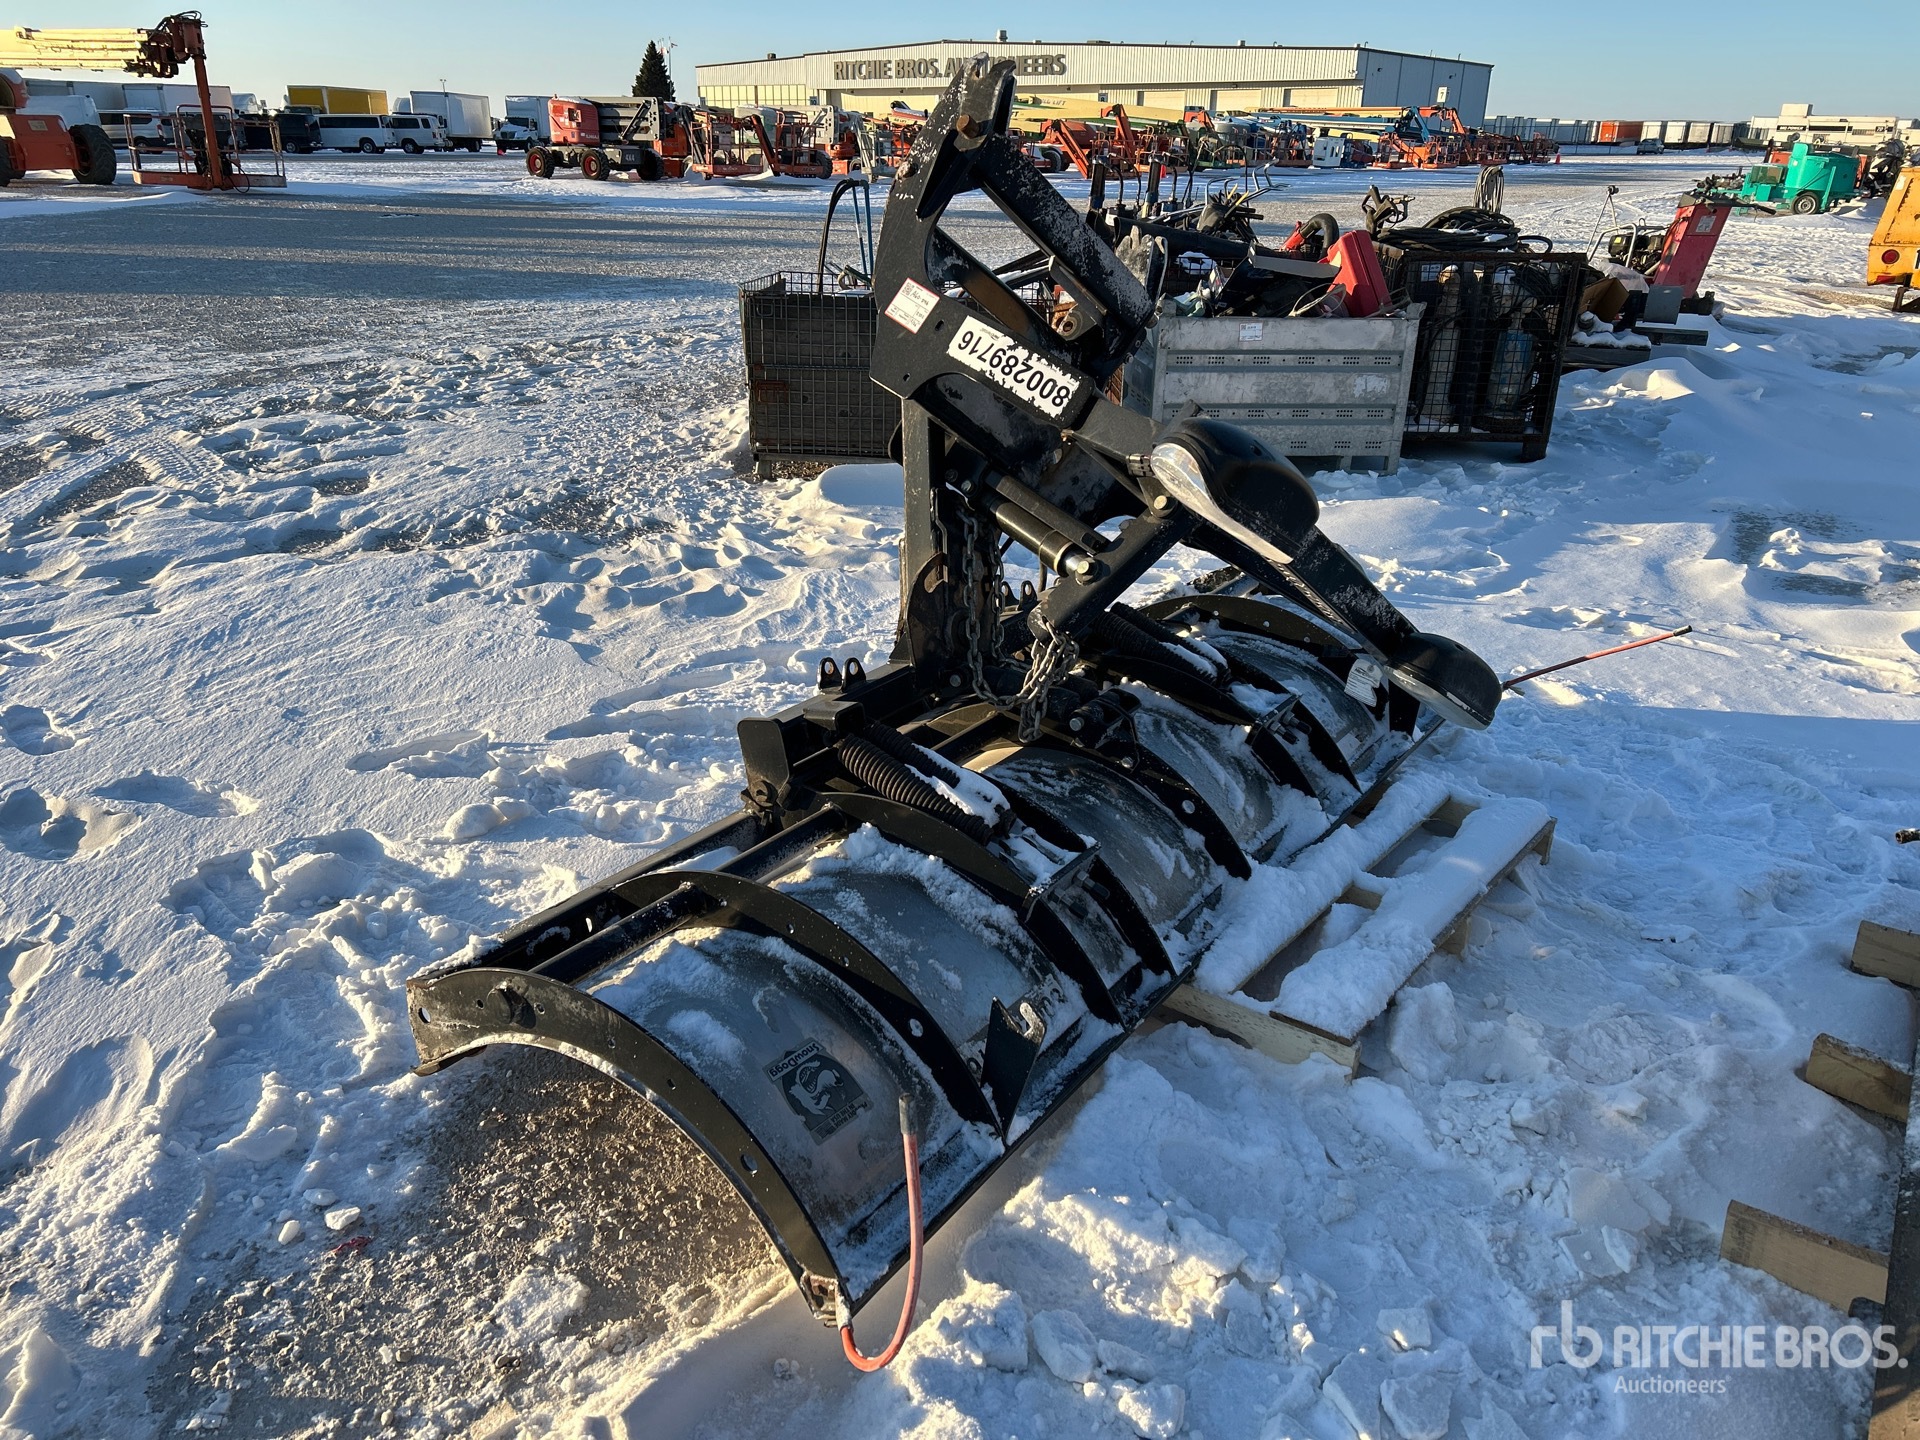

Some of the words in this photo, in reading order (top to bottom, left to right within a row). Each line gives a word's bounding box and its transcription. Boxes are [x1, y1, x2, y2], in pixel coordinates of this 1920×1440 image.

[833, 60, 893, 80] RITCHIE
[895, 58, 943, 79] BROS.
[944, 54, 1067, 77] AINEERS
[957, 330, 1071, 408] 800289716
[769, 1043, 820, 1078] SnowDogg
